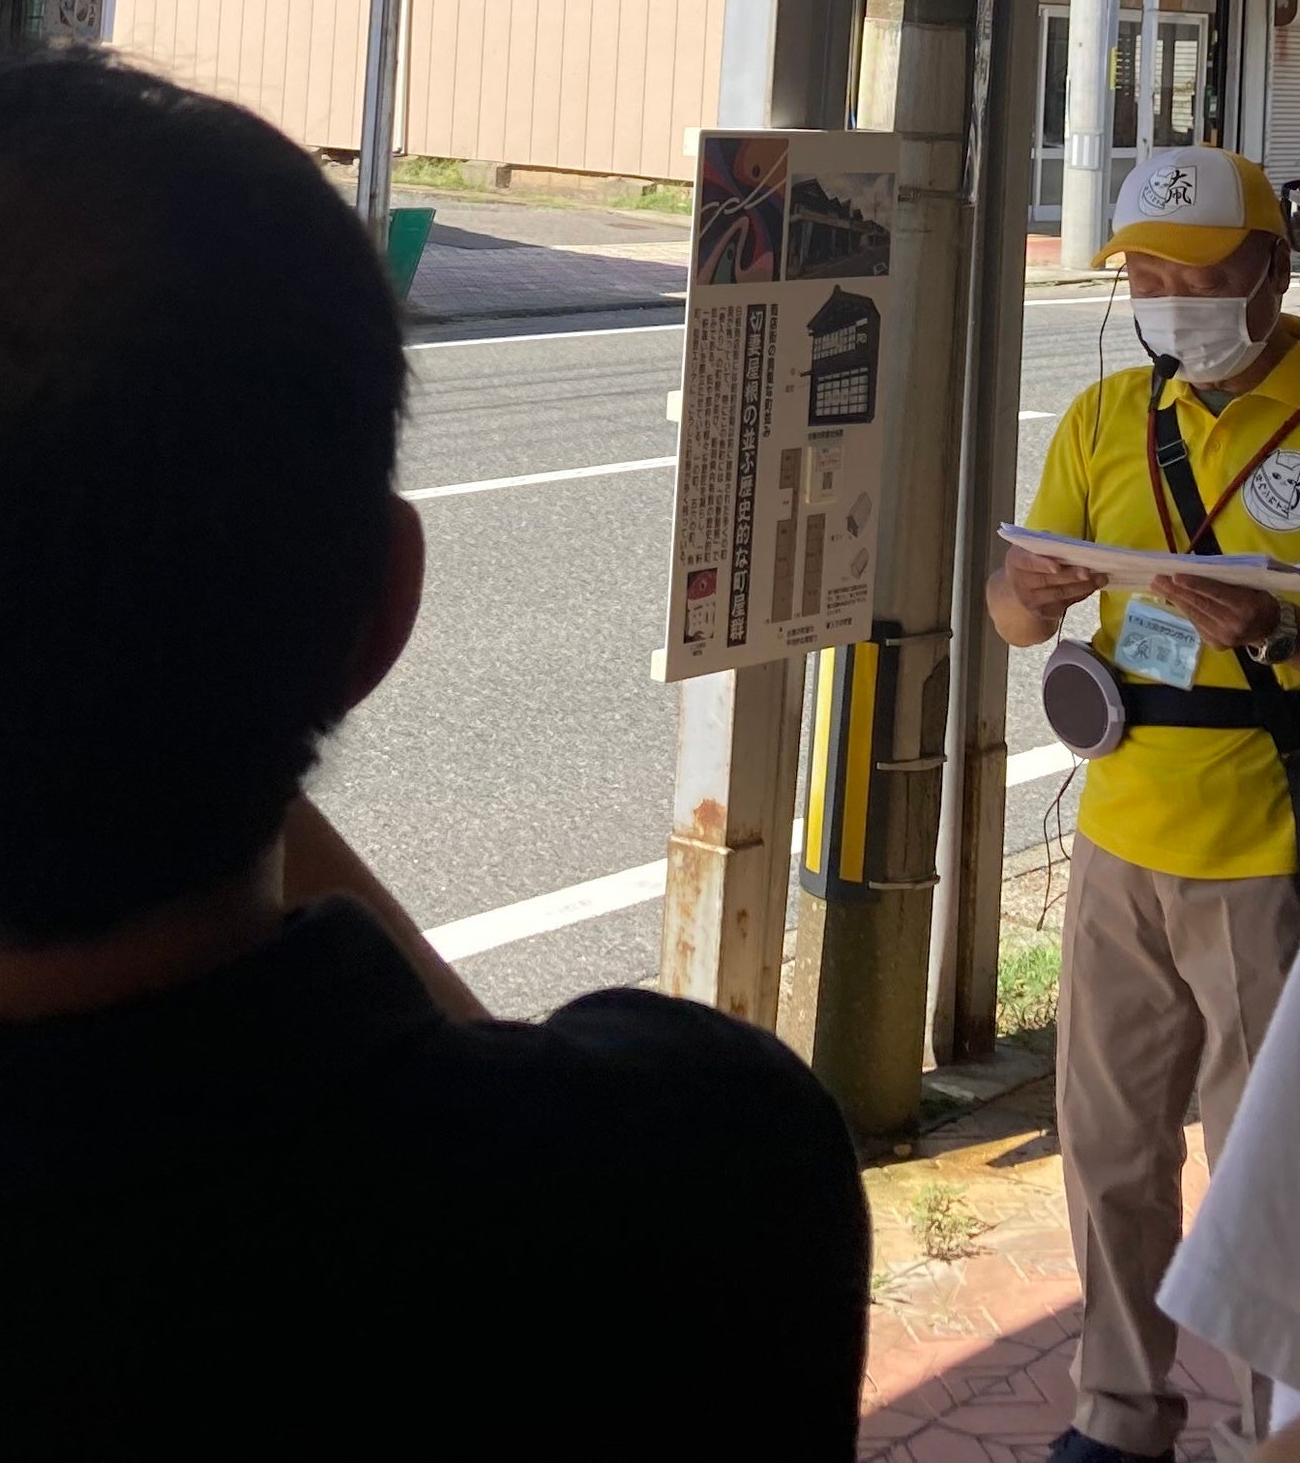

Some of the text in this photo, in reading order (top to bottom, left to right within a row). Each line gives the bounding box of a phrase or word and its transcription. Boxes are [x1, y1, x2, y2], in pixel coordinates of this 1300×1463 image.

[730, 310, 764, 641] 切妻屋根の並ぶ歴史的な町屋群
